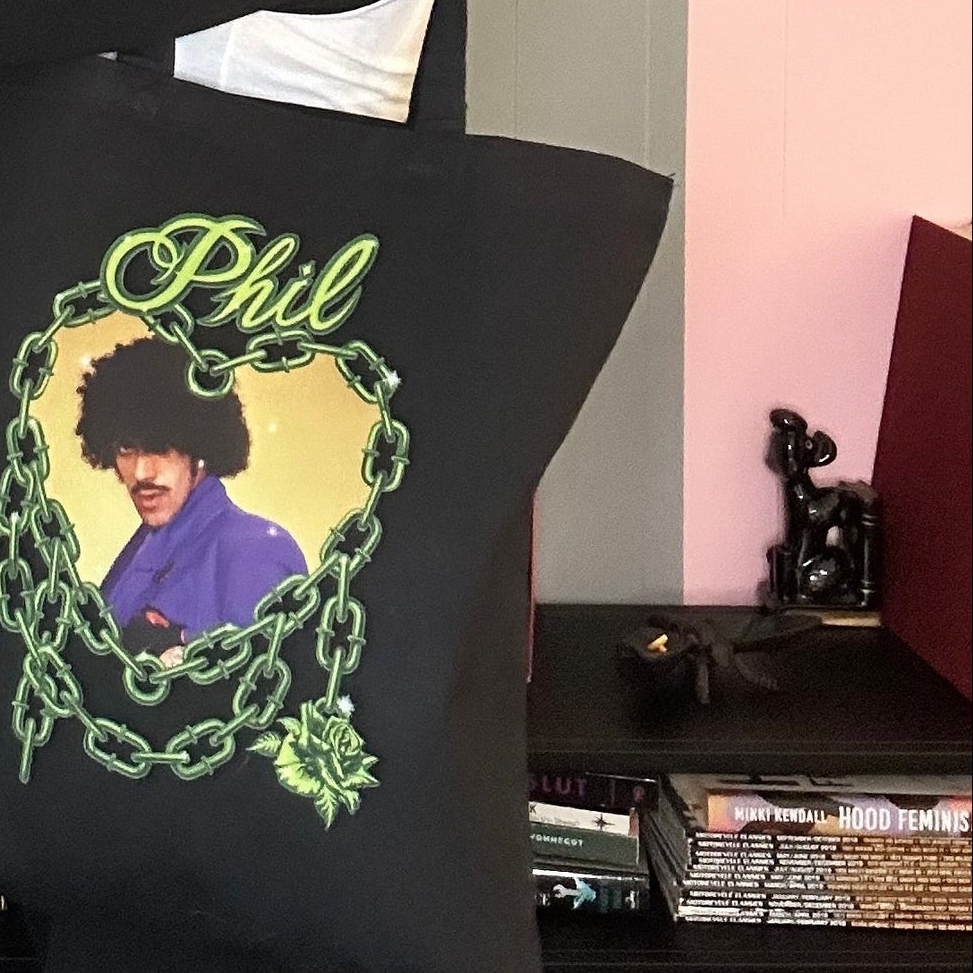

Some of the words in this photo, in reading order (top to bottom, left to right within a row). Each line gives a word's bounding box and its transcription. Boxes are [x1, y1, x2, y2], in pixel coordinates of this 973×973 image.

[101, 213, 378, 334] Phil
[734, 806, 770, 823] MIKKI
[774, 807, 827, 825] KENDALL
[838, 805, 891, 832] HOOD
[898, 807, 972, 833] FEMINIS
